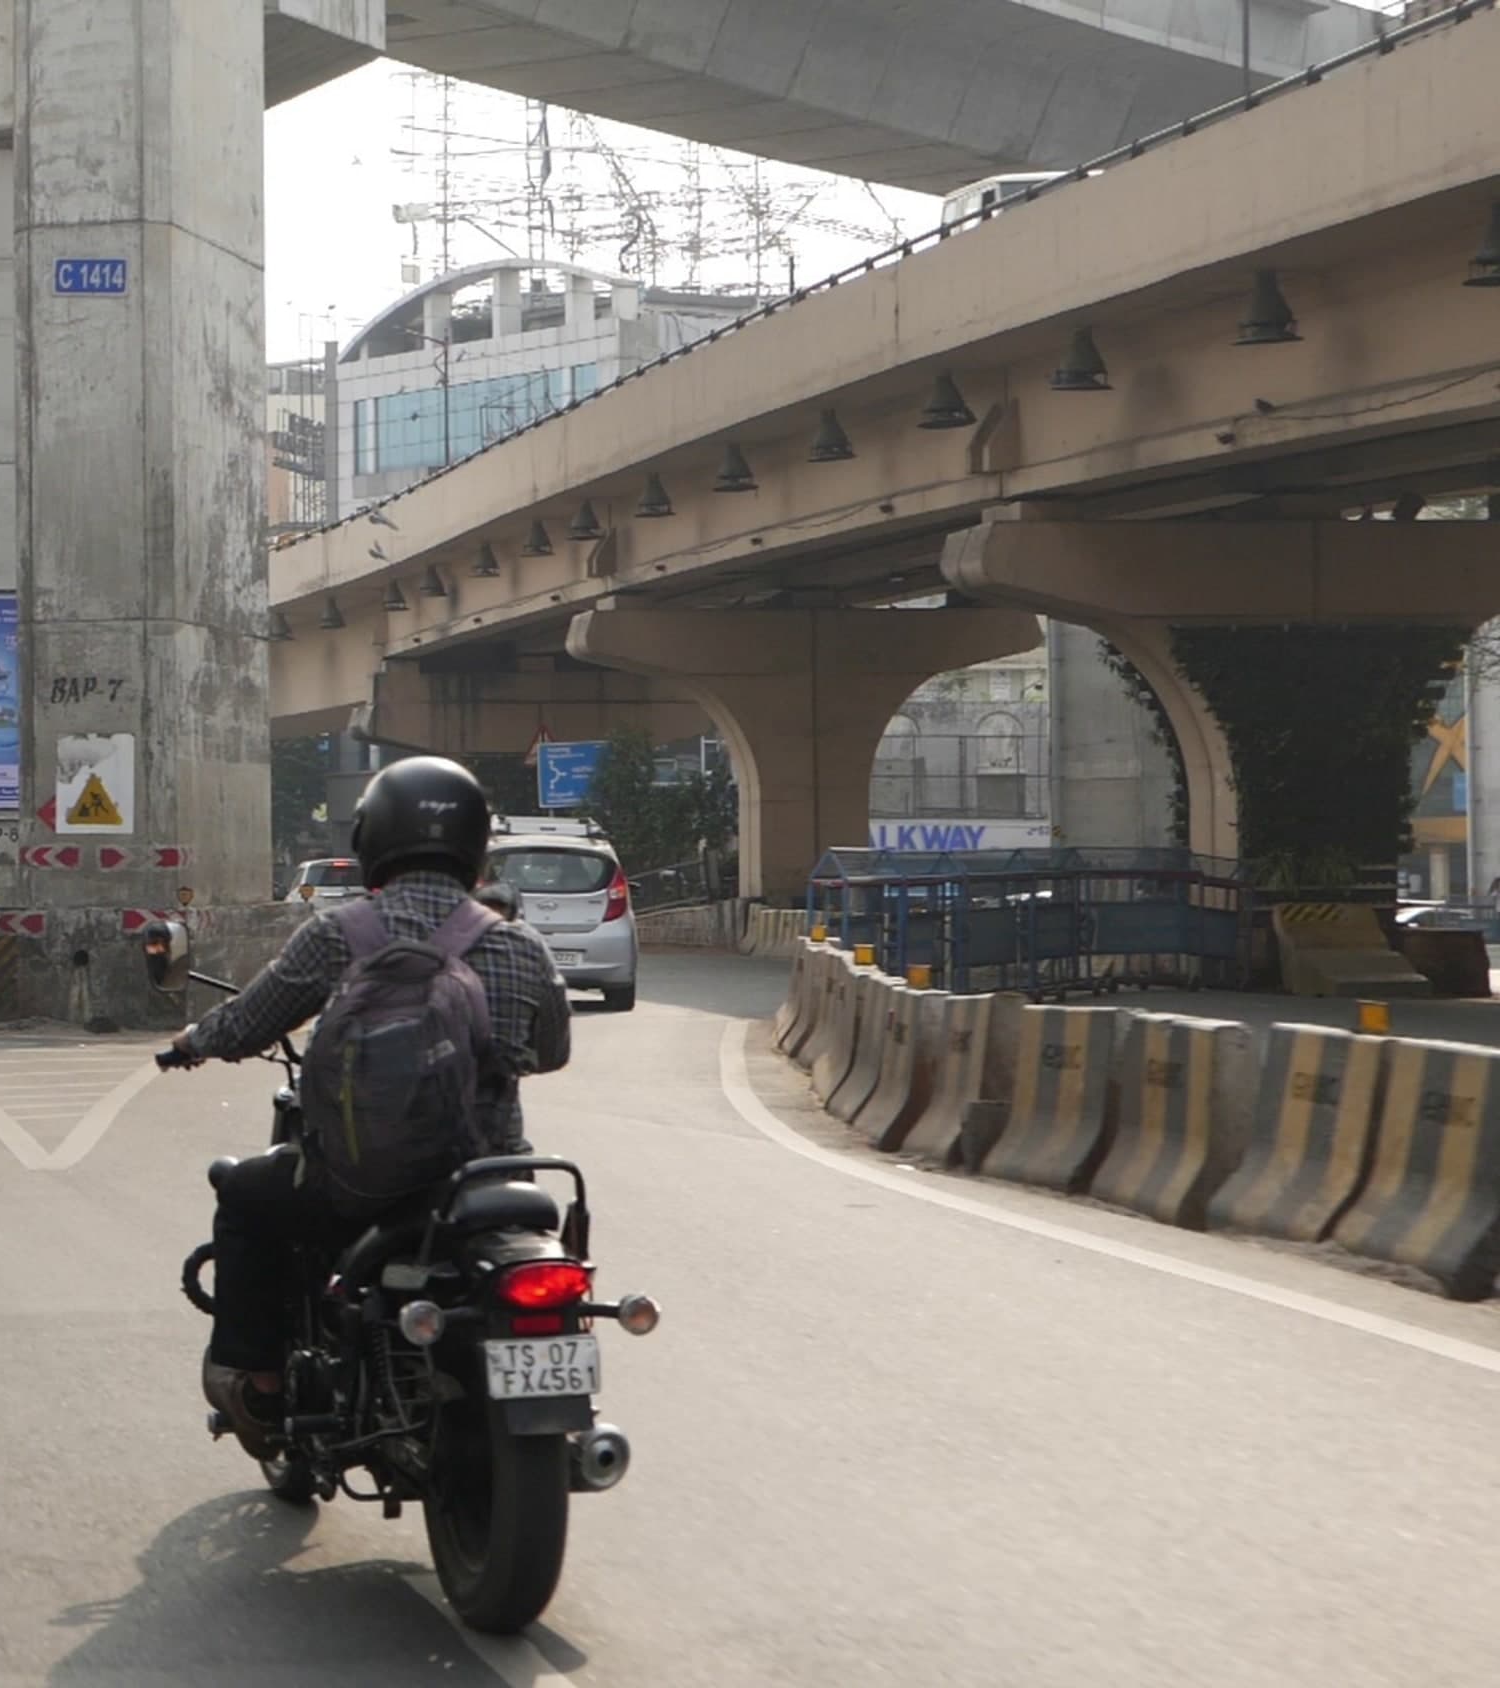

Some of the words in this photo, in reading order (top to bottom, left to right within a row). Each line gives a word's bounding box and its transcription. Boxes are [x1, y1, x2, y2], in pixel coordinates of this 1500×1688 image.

[58, 263, 73, 289] C
[79, 263, 124, 289] 1414
[504, 1344, 537, 1368] TS
[547, 1341, 579, 1366] 07
